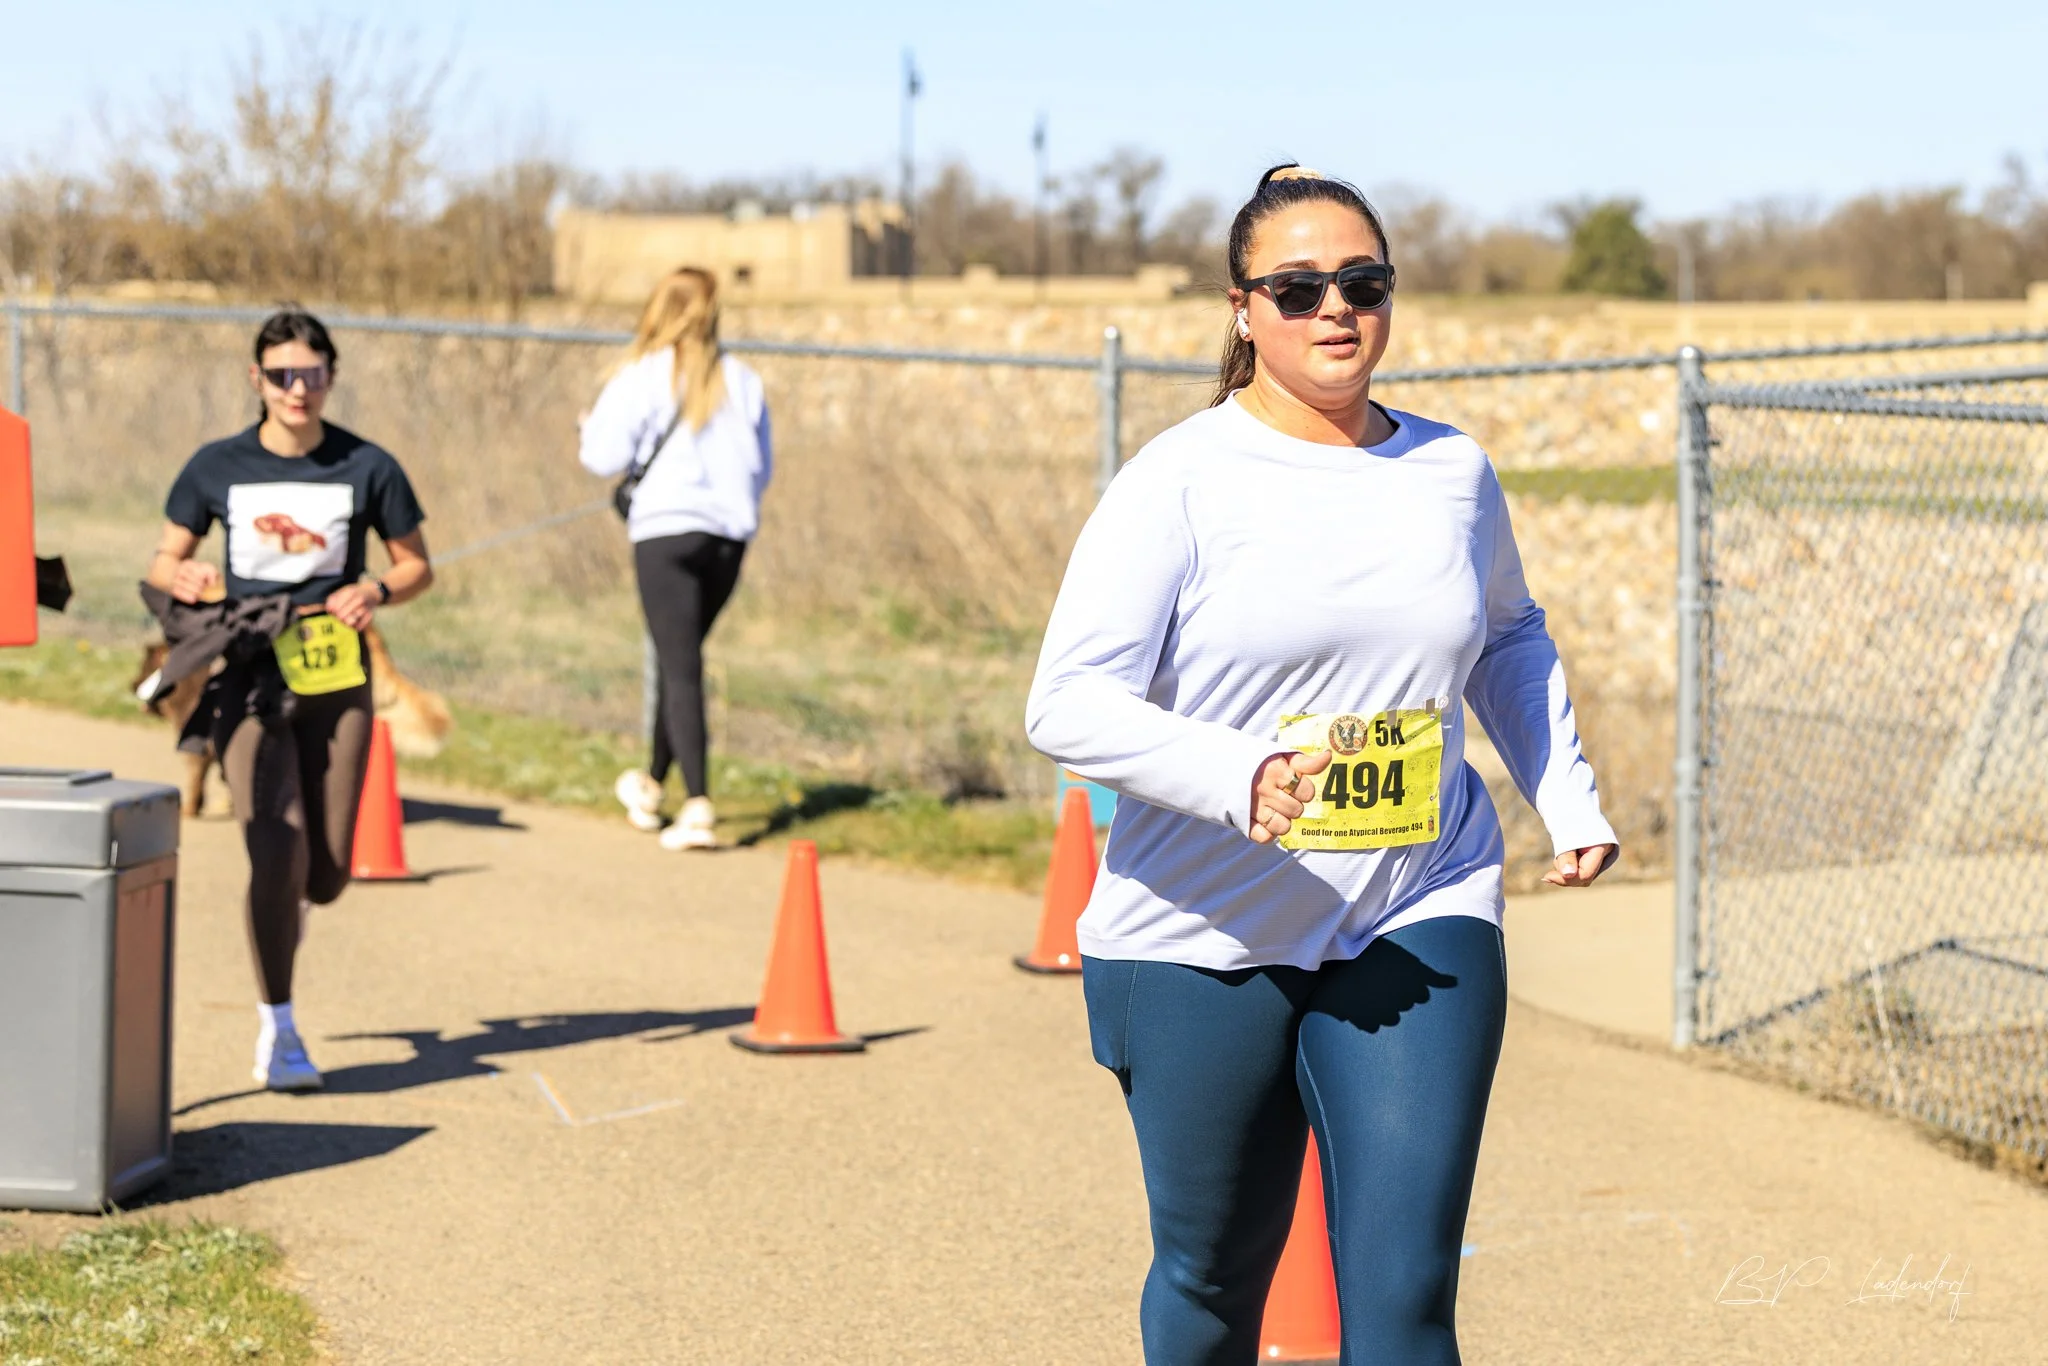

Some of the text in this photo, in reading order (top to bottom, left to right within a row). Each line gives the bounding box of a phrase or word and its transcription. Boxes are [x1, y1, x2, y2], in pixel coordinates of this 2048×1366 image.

[1374, 718, 1406, 747] 5K
[1322, 759, 1406, 810] 494
[1301, 828, 1321, 837] Good
[1322, 828, 1333, 837] for
[1349, 828, 1378, 837] Atypical
[1379, 825, 1410, 836] Beverage
[1410, 822, 1423, 831] 494
